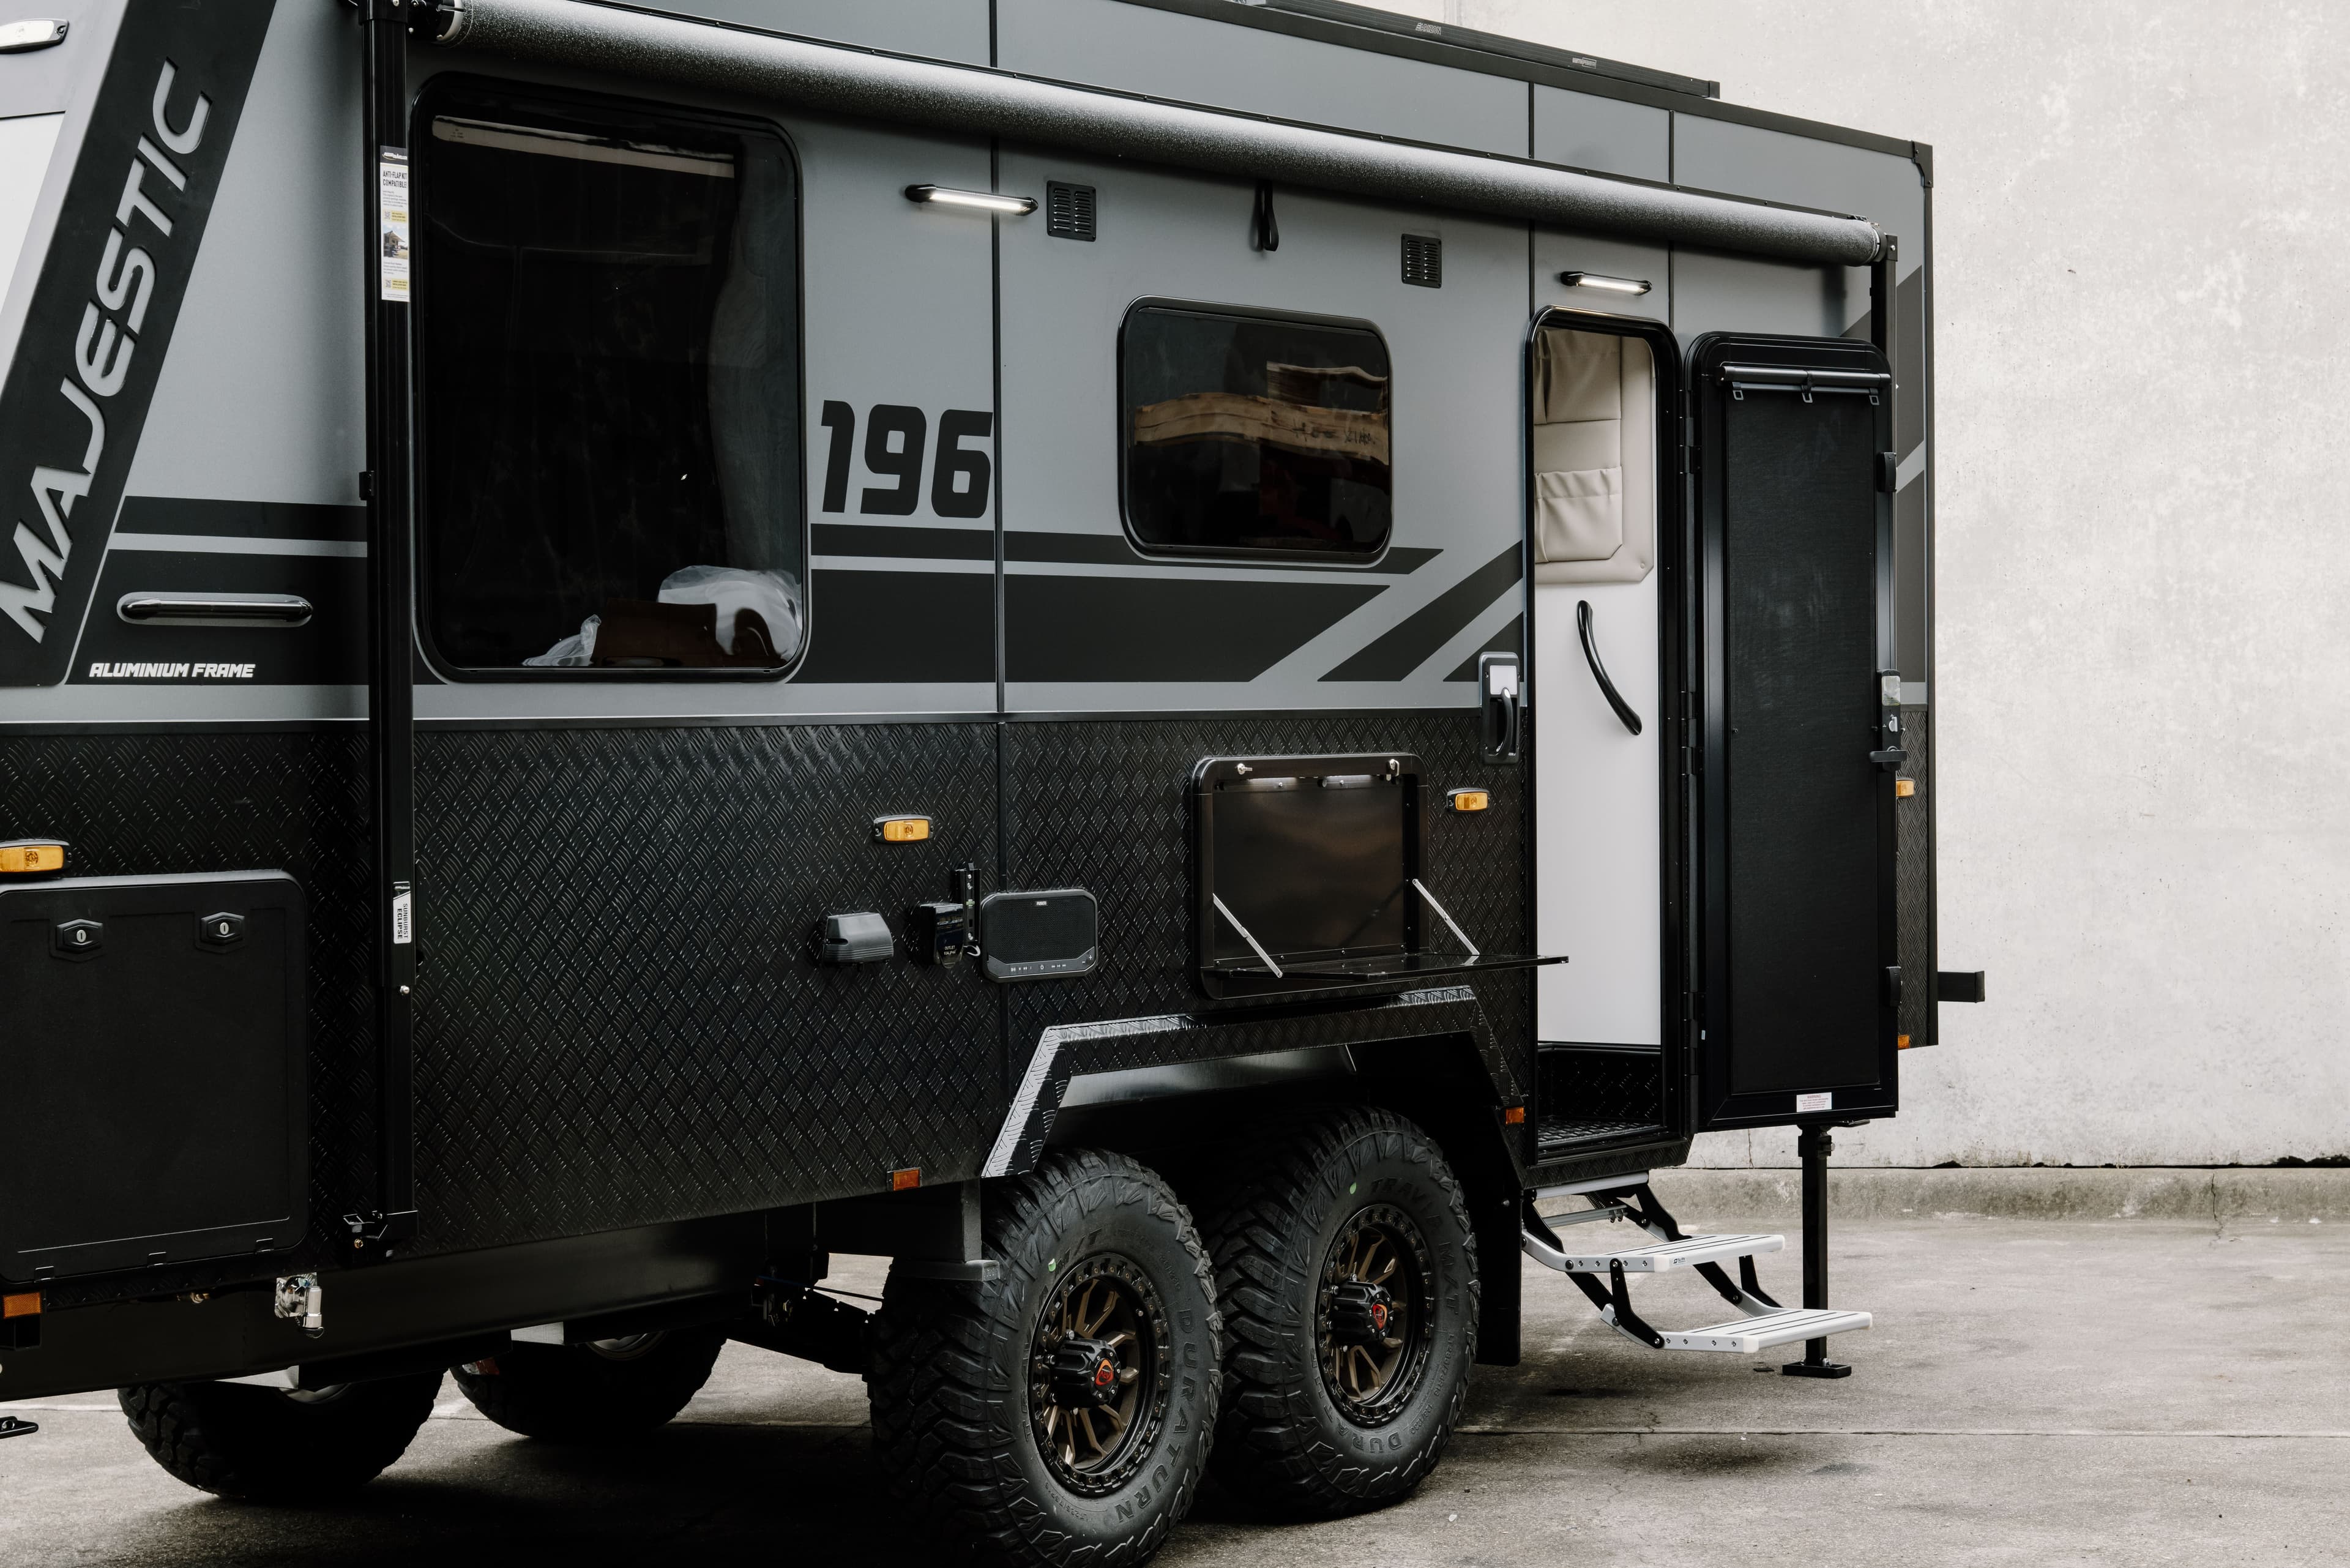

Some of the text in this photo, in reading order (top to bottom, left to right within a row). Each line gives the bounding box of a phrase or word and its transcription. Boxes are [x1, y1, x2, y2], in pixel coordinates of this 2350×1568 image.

[382, 170, 401, 179] ANTI-FLAP
[0, 57, 213, 644] MAJESTIC
[821, 400, 993, 518] 196
[89, 663, 256, 678] ALUMINIUM FRAME
[1116, 1309, 1198, 1523] DURATURN
